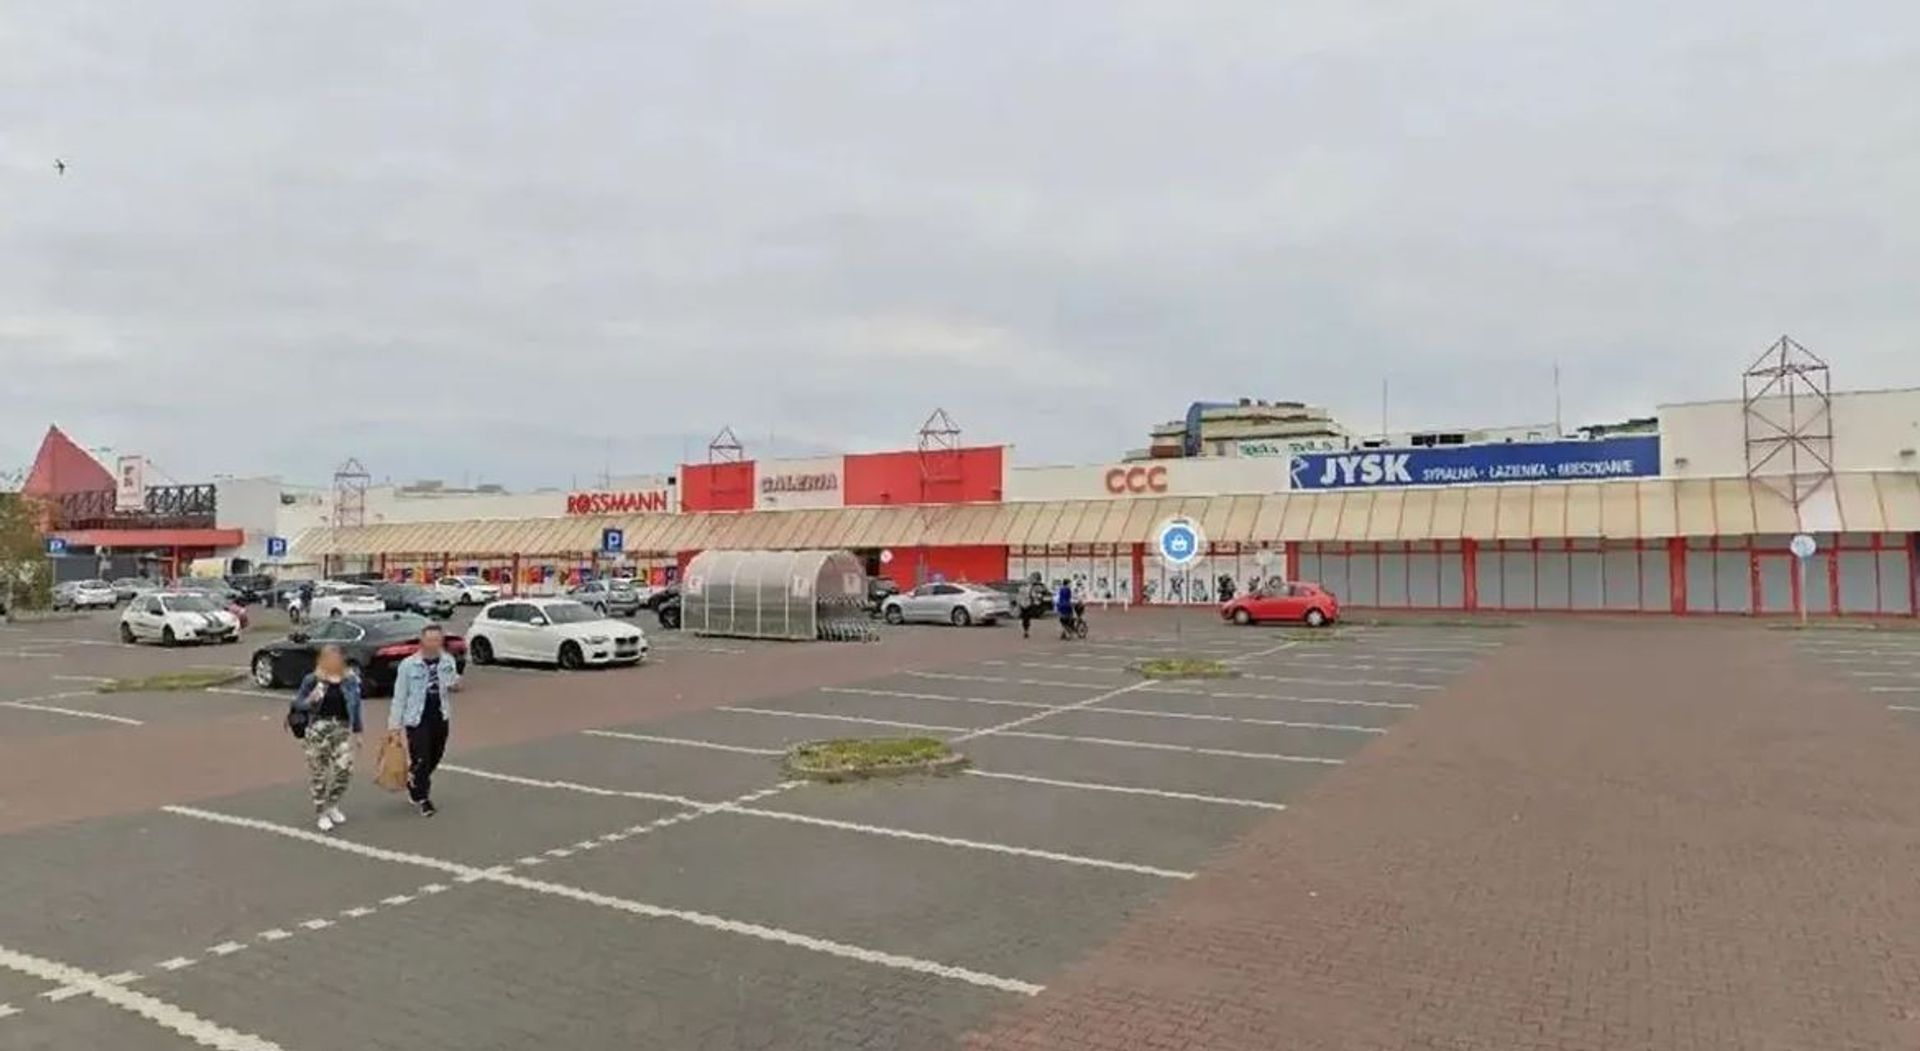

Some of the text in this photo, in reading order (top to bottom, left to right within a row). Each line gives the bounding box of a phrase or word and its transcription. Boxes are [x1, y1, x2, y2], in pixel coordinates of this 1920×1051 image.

[762, 472, 838, 493] GALERIA
[1105, 466, 1168, 494] CCC
[1319, 453, 1412, 486] JYSK
[1488, 463, 1548, 479] ŁAZIENKA
[566, 490, 668, 515] ROSSMANN
